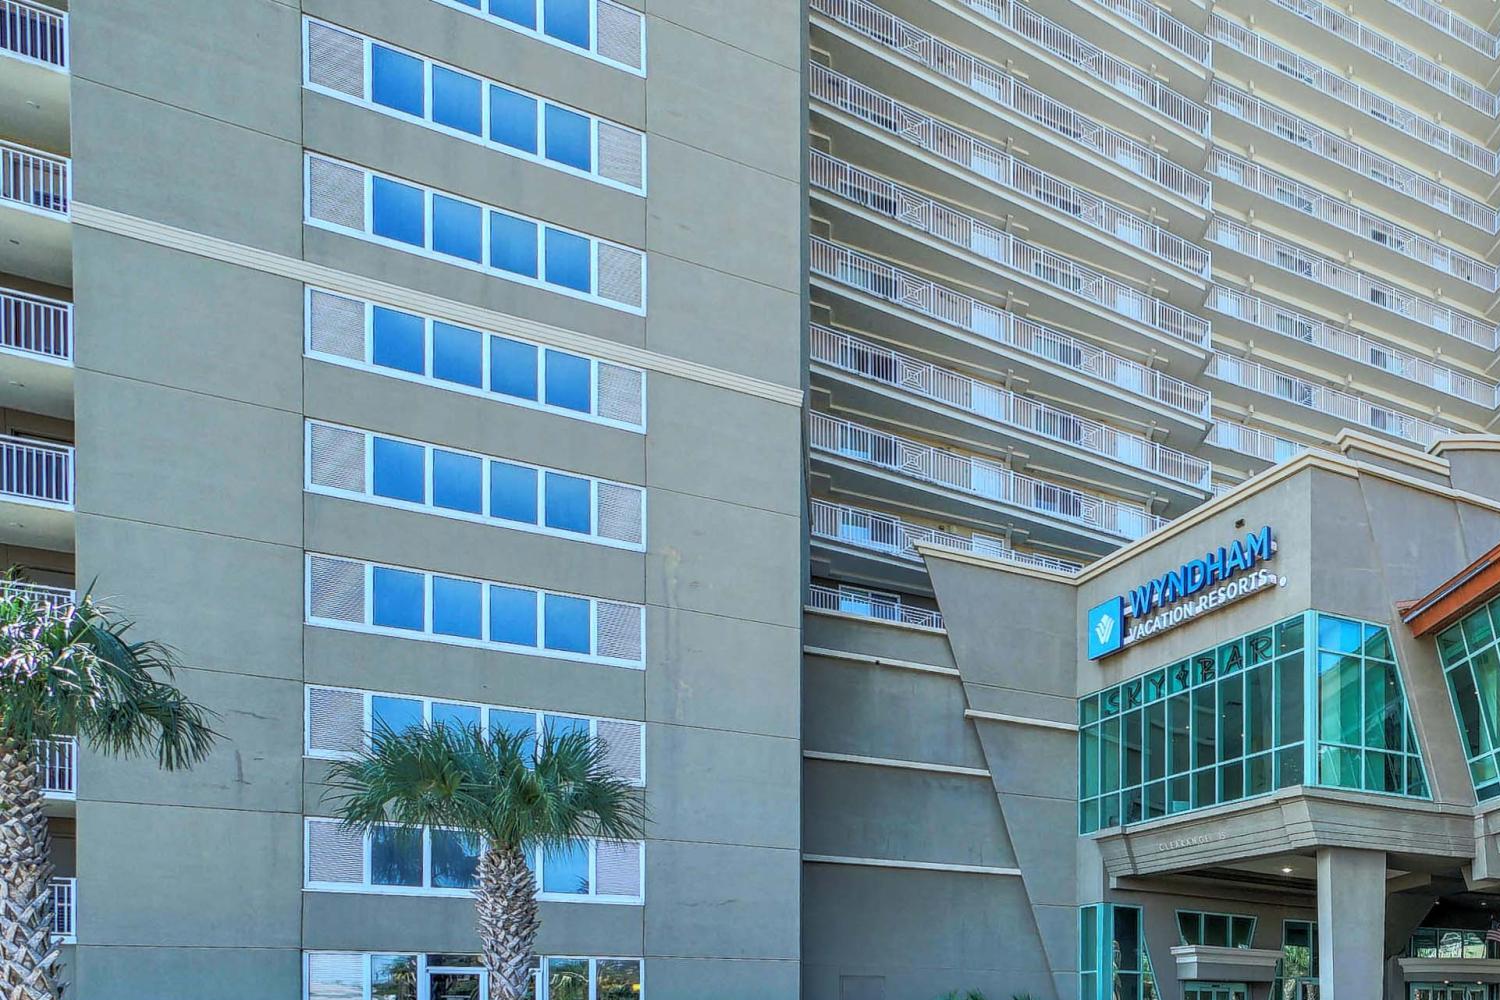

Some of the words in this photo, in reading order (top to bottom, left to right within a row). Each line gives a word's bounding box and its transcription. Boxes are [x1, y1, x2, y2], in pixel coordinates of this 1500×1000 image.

[1128, 600, 1193, 643] VACATION
[1199, 568, 1269, 611] RESORTS
[1129, 525, 1272, 619] WYNDHAM
[1104, 673, 1166, 716] SKY
[1197, 635, 1273, 682] BAR
